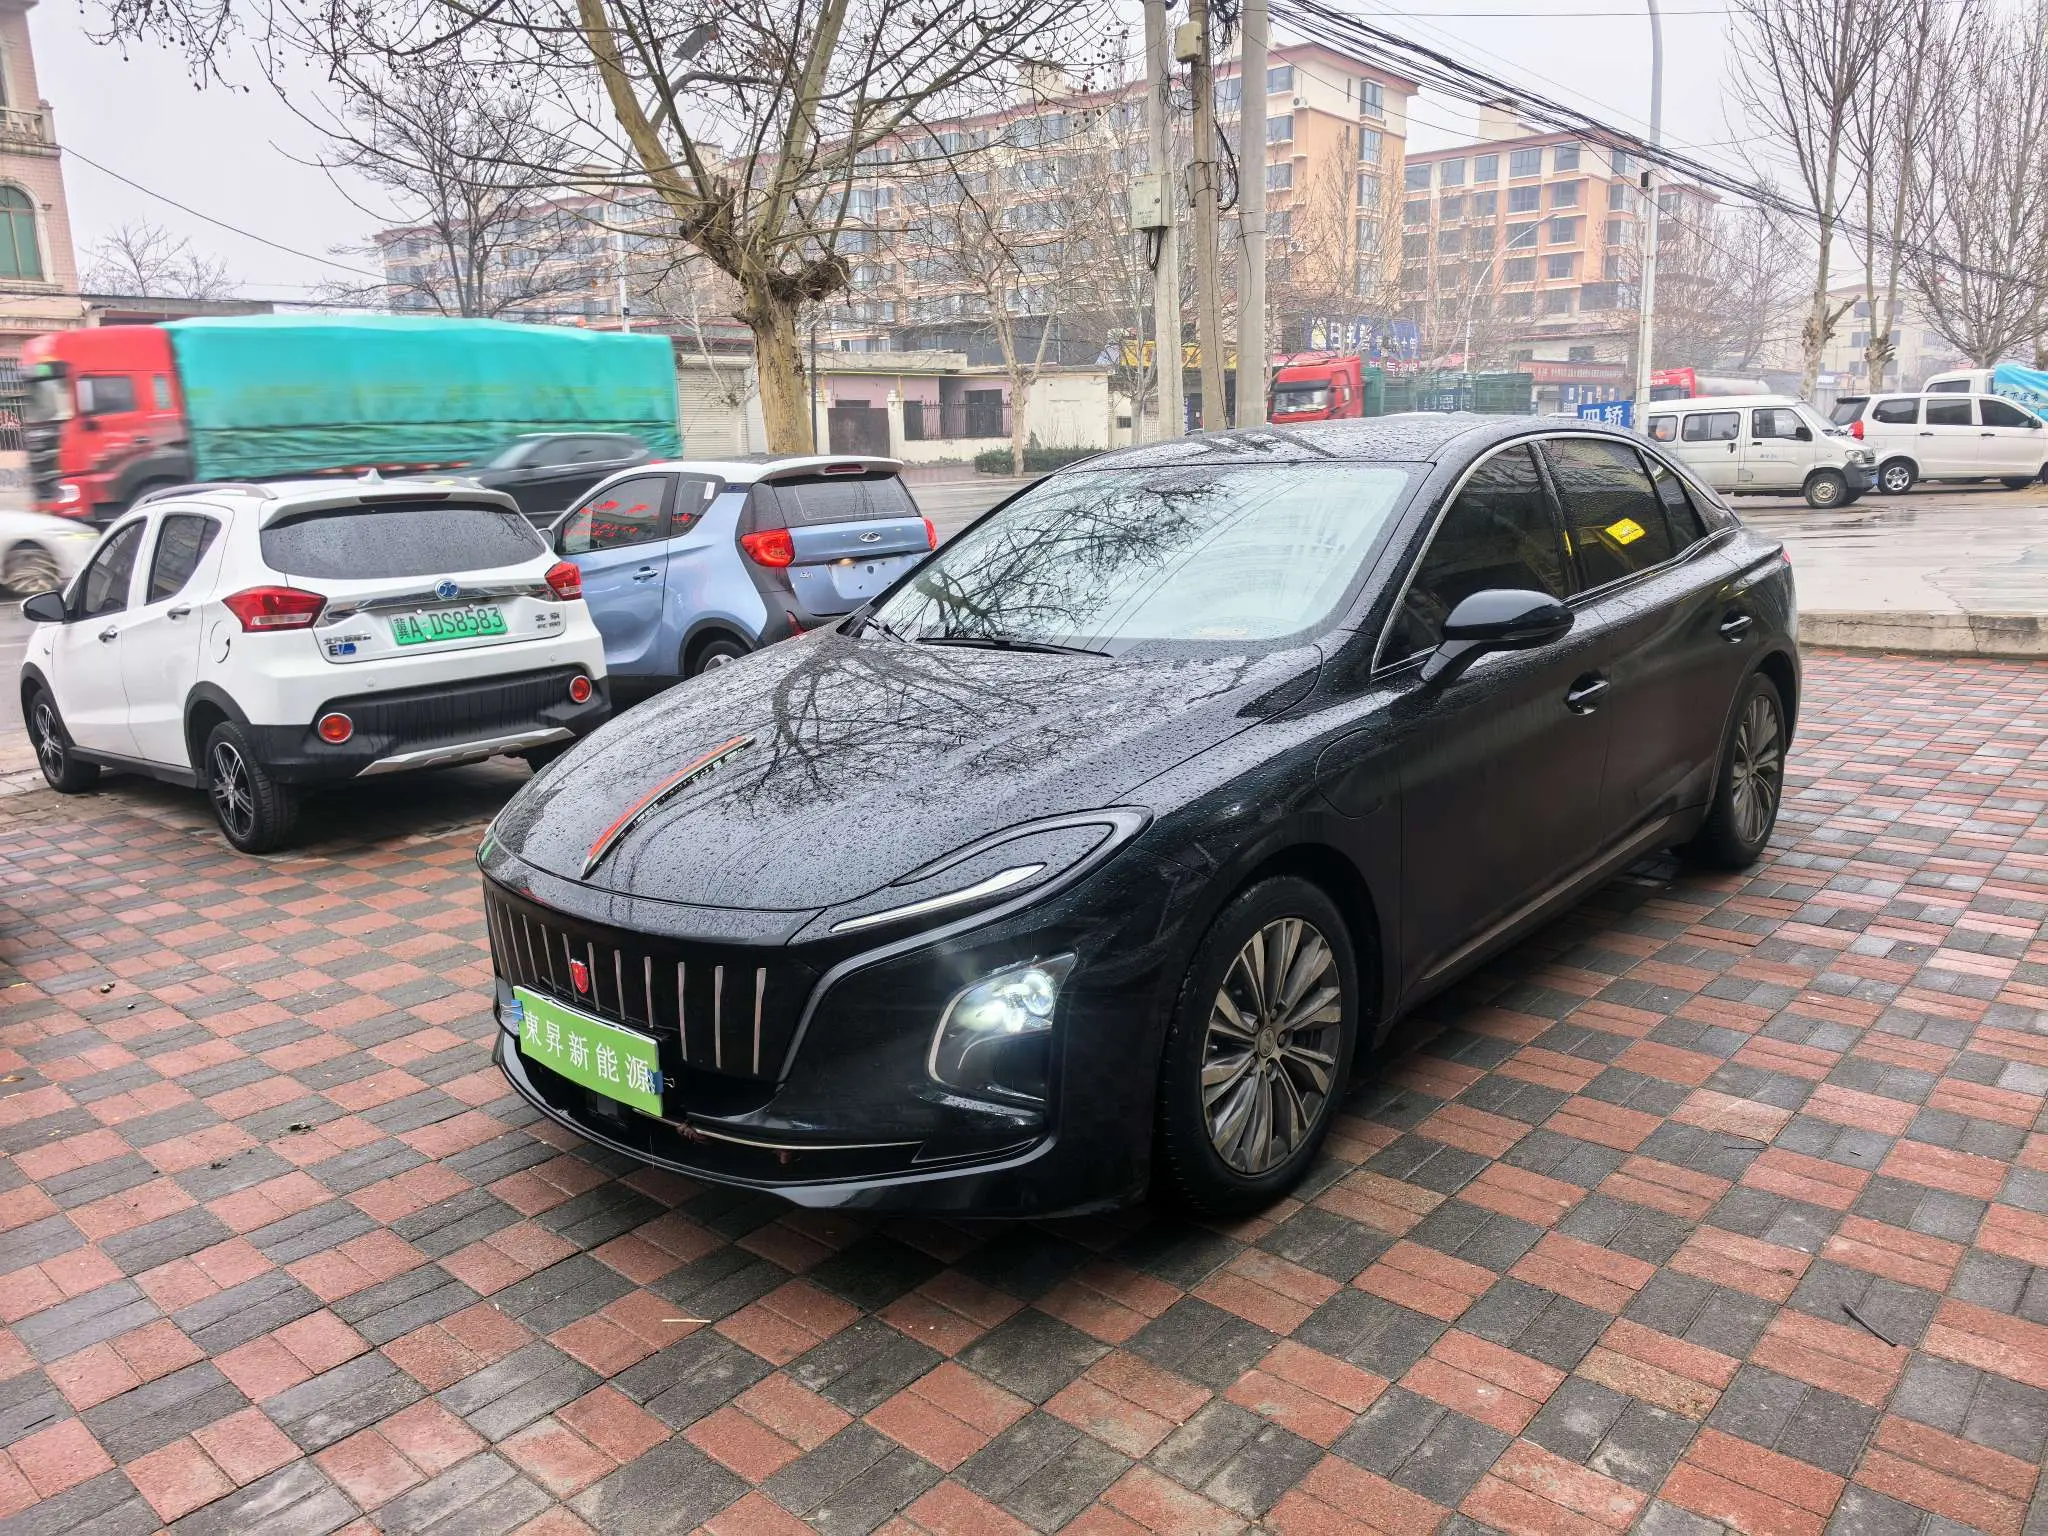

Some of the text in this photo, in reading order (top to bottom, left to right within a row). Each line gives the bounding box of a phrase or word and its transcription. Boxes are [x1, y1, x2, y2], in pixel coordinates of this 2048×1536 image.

[523, 1010, 656, 1096] 東昇新能源
